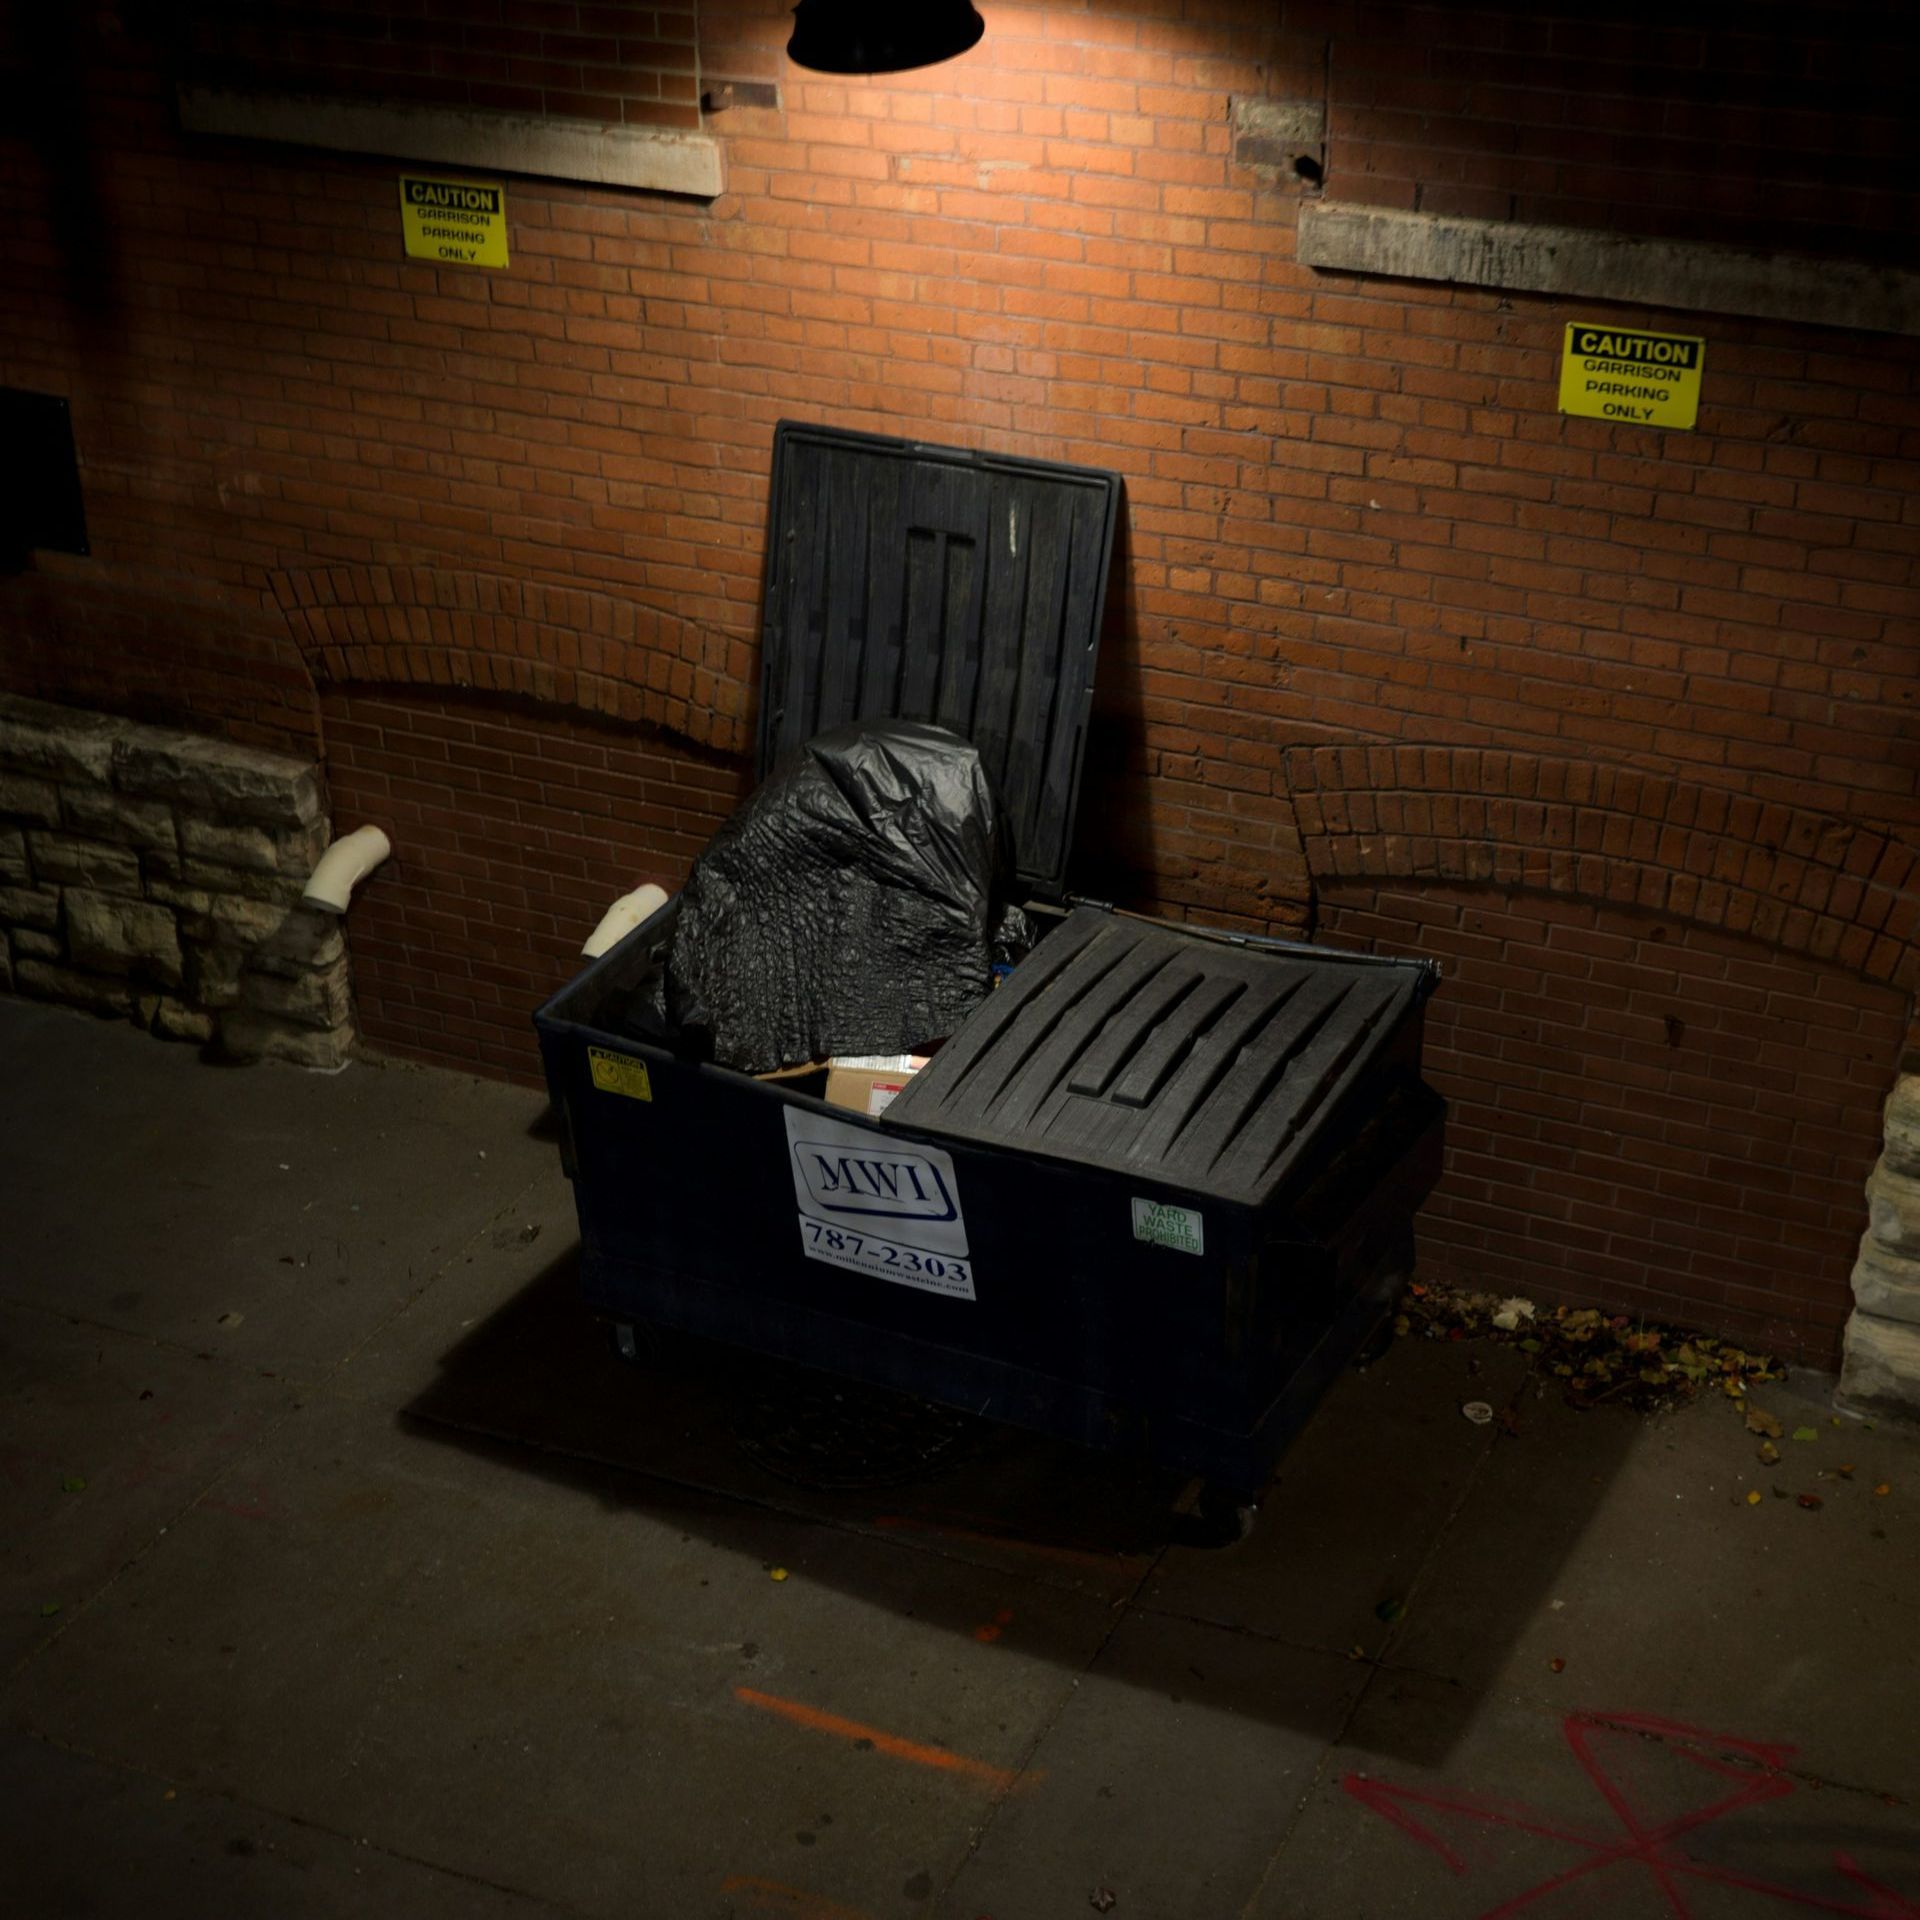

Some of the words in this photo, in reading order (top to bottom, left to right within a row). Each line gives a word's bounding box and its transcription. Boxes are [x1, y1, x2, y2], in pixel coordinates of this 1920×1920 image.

[411, 184, 494, 211] CAUTION
[417, 208, 490, 227] GARRISON
[422, 226, 485, 245] PARKING
[438, 246, 477, 262] ONLY
[1580, 332, 1691, 365] CAUTION
[1584, 359, 1681, 382] GARRISON
[1586, 380, 1669, 402] PARKING
[1603, 402, 1655, 421] ONLY
[812, 1153, 932, 1203] MWI
[1148, 1203, 1187, 1224] YARD
[1138, 1225, 1199, 1250] PROHIBITED
[1143, 1214, 1193, 1238] WASTE
[805, 1222, 968, 1283] 787-2303
